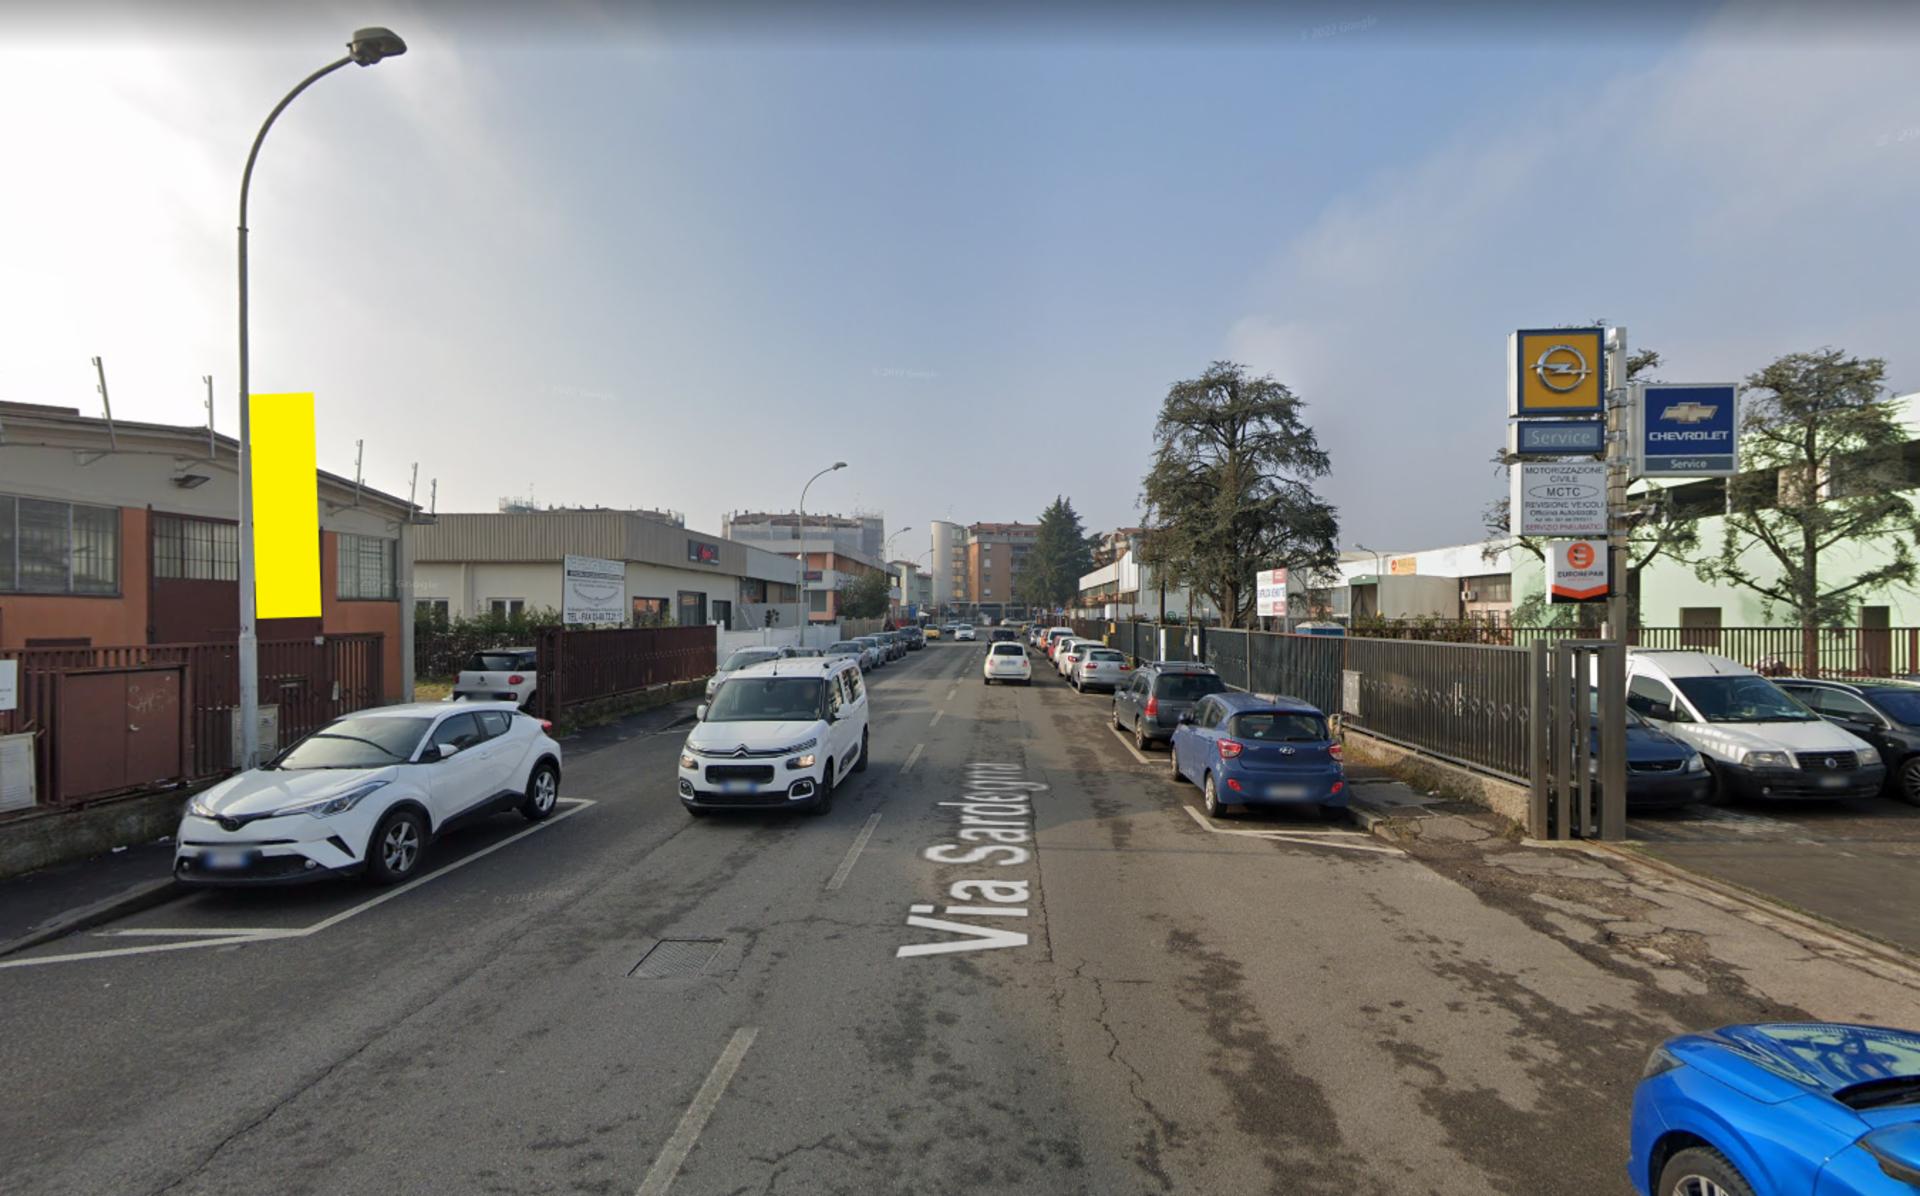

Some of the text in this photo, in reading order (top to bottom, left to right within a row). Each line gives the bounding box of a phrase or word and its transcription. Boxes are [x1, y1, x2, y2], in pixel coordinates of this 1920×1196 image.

[1531, 430, 1591, 445] Service
[1648, 430, 1729, 441] CHEVROLET
[1670, 458, 1707, 469] Service
[1525, 466, 1604, 474] MOTORIZZAZIONE
[1550, 475, 1579, 483] CIVILE
[1546, 487, 1581, 497] MCTC
[1525, 501, 1569, 509] REVISIONE
